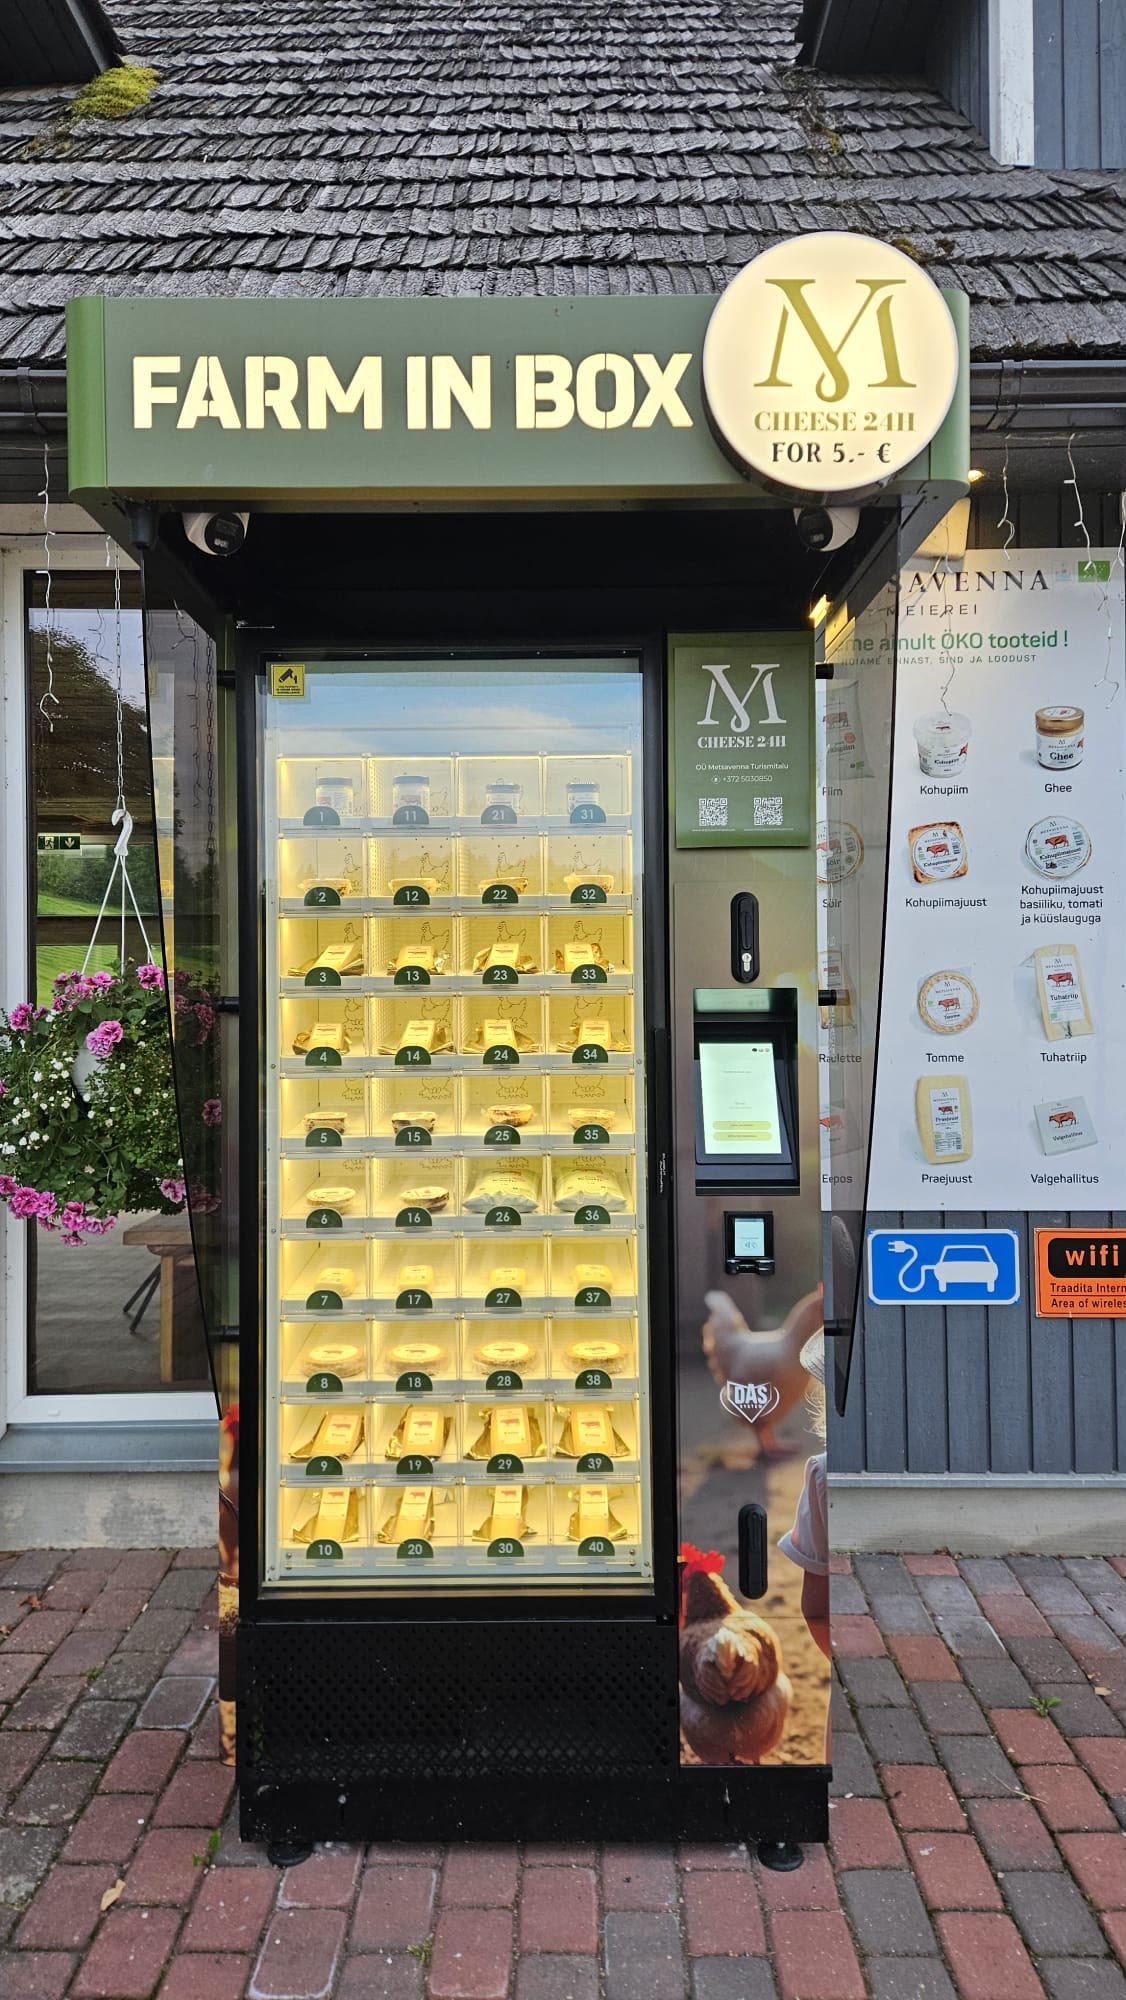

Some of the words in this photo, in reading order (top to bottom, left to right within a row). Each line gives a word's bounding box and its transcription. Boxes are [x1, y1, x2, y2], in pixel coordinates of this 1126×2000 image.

[132, 355, 384, 430] FARM
[406, 355, 491, 430] IN
[515, 352, 694, 429] BOX
[754, 411, 857, 432] CHEESE
[863, 411, 916, 432] 24H
[772, 442, 822, 463] FOR
[832, 442, 865, 463] 5.-
[876, 442, 892, 463] €
[886, 603, 977, 616] MEIEREI
[879, 632, 936, 651] ainult
[941, 629, 983, 650] ÖKO
[988, 629, 1058, 648] tooteid
[1064, 629, 1069, 648] !
[939, 656, 964, 665] SIND
[969, 655, 983, 664] JA
[988, 654, 1037, 664] LOODUST
[697, 735, 755, 749] CHEESE
[757, 734, 787, 748] 24H
[708, 763, 750, 771] Metsavenna
[750, 762, 789, 770] Turismitalu
[920, 784, 969, 797] Kohupiim
[1044, 783, 1073, 793] Ghee
[319, 811, 324, 822] 1
[405, 810, 416, 821] 11
[492, 809, 505, 820] 21
[580, 809, 593, 820] 31
[405, 891, 419, 901] 12
[493, 889, 508, 900] 22
[581, 889, 596, 900] 32
[1021, 885, 1104, 897] Kohupiimajuust
[318, 892, 326, 902] 2
[905, 897, 988, 910] Kohupiimajuust
[1019, 899, 1066, 910] basiiliku,
[1067, 899, 1103, 909] tomati
[1021, 914, 1031, 926] ja
[1033, 913, 1101, 926] küüslauguga
[319, 972, 327, 982] 3
[406, 971, 419, 981] 13
[493, 970, 508, 980] 23
[582, 969, 596, 979] 33
[319, 1052, 327, 1062] 4
[407, 1051, 420, 1061] 14
[494, 1050, 508, 1060] 24
[583, 1049, 597, 1059] 34
[926, 1052, 965, 1063] Tomme
[1040, 1052, 1087, 1064] Tuhatriip
[320, 1132, 327, 1143] 5
[407, 1132, 421, 1142] 15
[495, 1130, 509, 1141] 25
[584, 1129, 599, 1140] 35
[822, 1174, 853, 1186] Eepos
[921, 1173, 973, 1186] Praejuust
[1030, 1173, 1100, 1186] Valgehallitus
[321, 1214, 328, 1224] 6
[408, 1212, 421, 1223] 16
[496, 1211, 510, 1222] 26
[585, 1210, 599, 1221] 36
[1065, 1244, 1119, 1267] wifi
[1050, 1282, 1093, 1293] Traadita
[321, 1295, 328, 1306] 7
[408, 1294, 421, 1305] 17
[496, 1293, 510, 1303] 27
[586, 1292, 600, 1303] 37
[1051, 1298, 1075, 1308] Area
[1078, 1298, 1089, 1308] of
[320, 1378, 328, 1389] 8
[408, 1377, 422, 1388] 18
[497, 1375, 511, 1386] 28
[586, 1374, 601, 1385] 38
[734, 1383, 768, 1405] DAS
[320, 1460, 328, 1472] 9
[408, 1460, 422, 1471] 19
[498, 1459, 512, 1470] 29
[588, 1458, 602, 1470] 39
[318, 1544, 332, 1556] 10
[408, 1544, 423, 1555] 20
[498, 1543, 513, 1554] 30
[588, 1541, 604, 1552] 40
